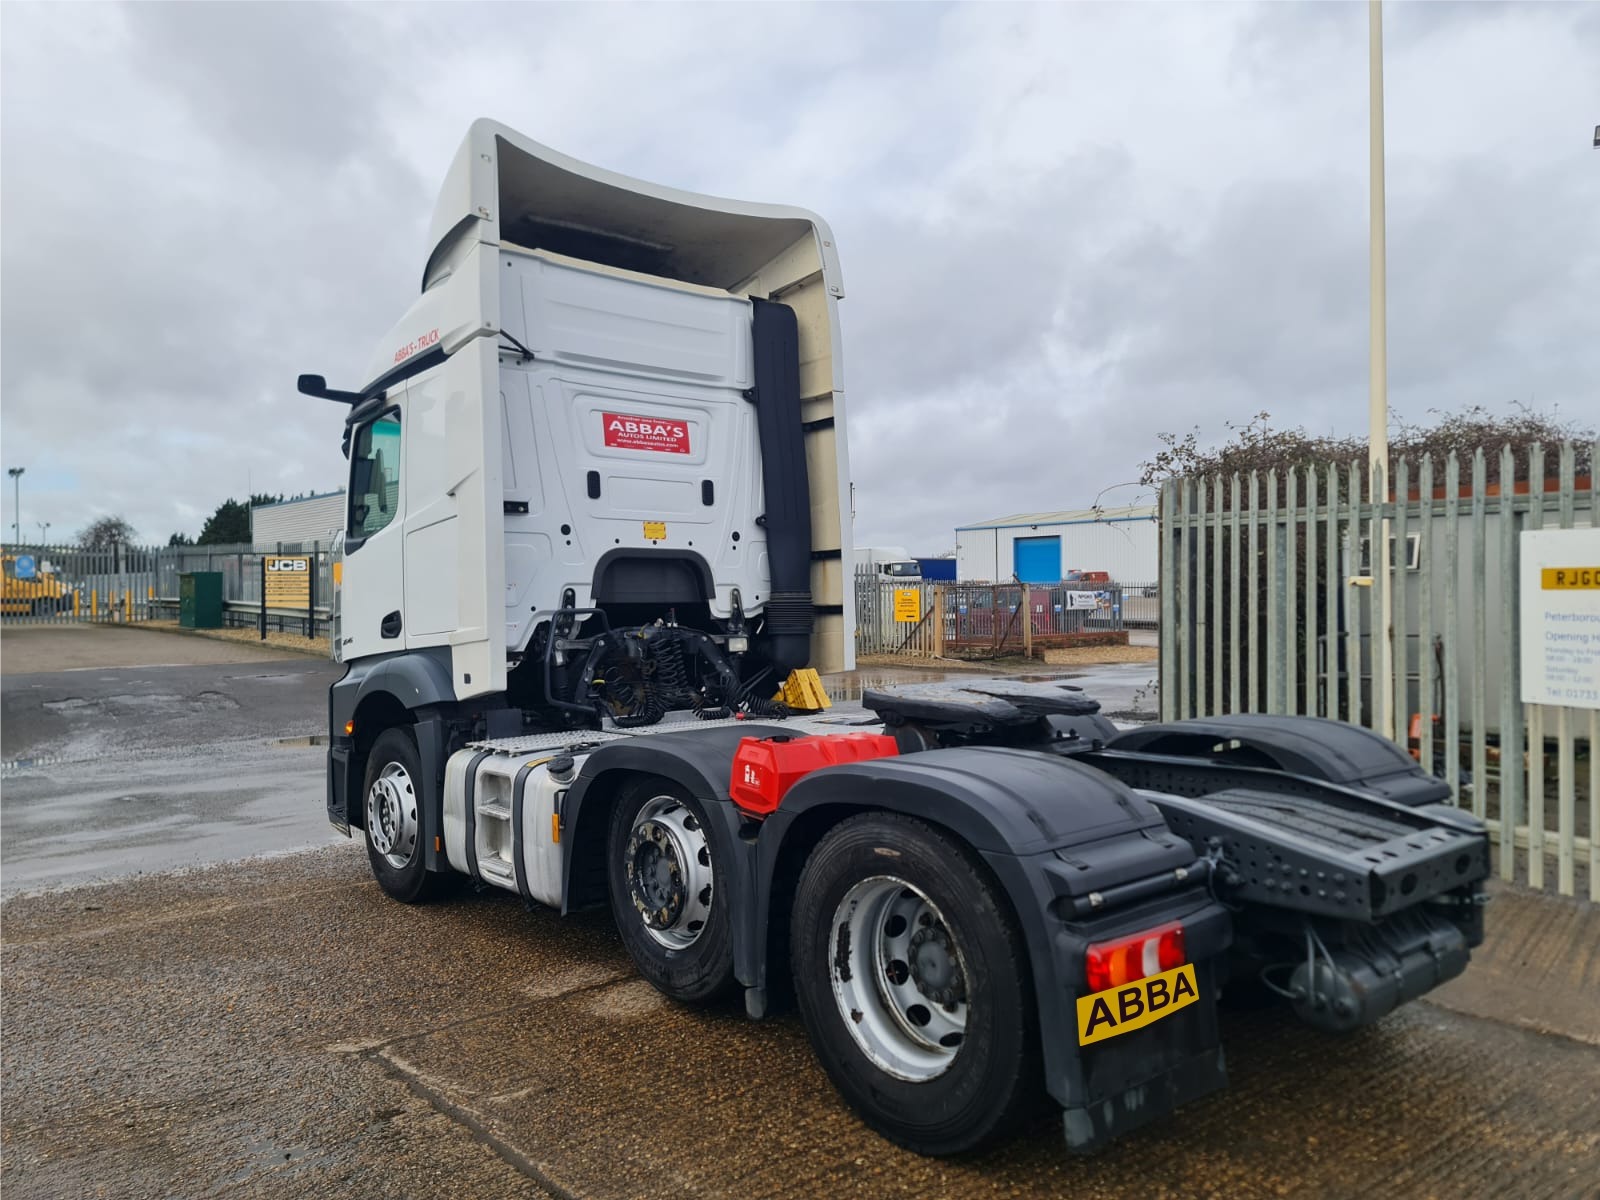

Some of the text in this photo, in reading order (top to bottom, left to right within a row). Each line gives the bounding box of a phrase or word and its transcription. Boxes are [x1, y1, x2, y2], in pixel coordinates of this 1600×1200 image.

[418, 328, 439, 349] TRUCK
[609, 420, 684, 438] ABBA'S
[646, 434, 677, 442] LIMITED
[268, 560, 306, 570] JCB
[1545, 631, 1589, 644] Opening
[1566, 689, 1598, 700] 01733
[1085, 972, 1195, 1037] ABBA
